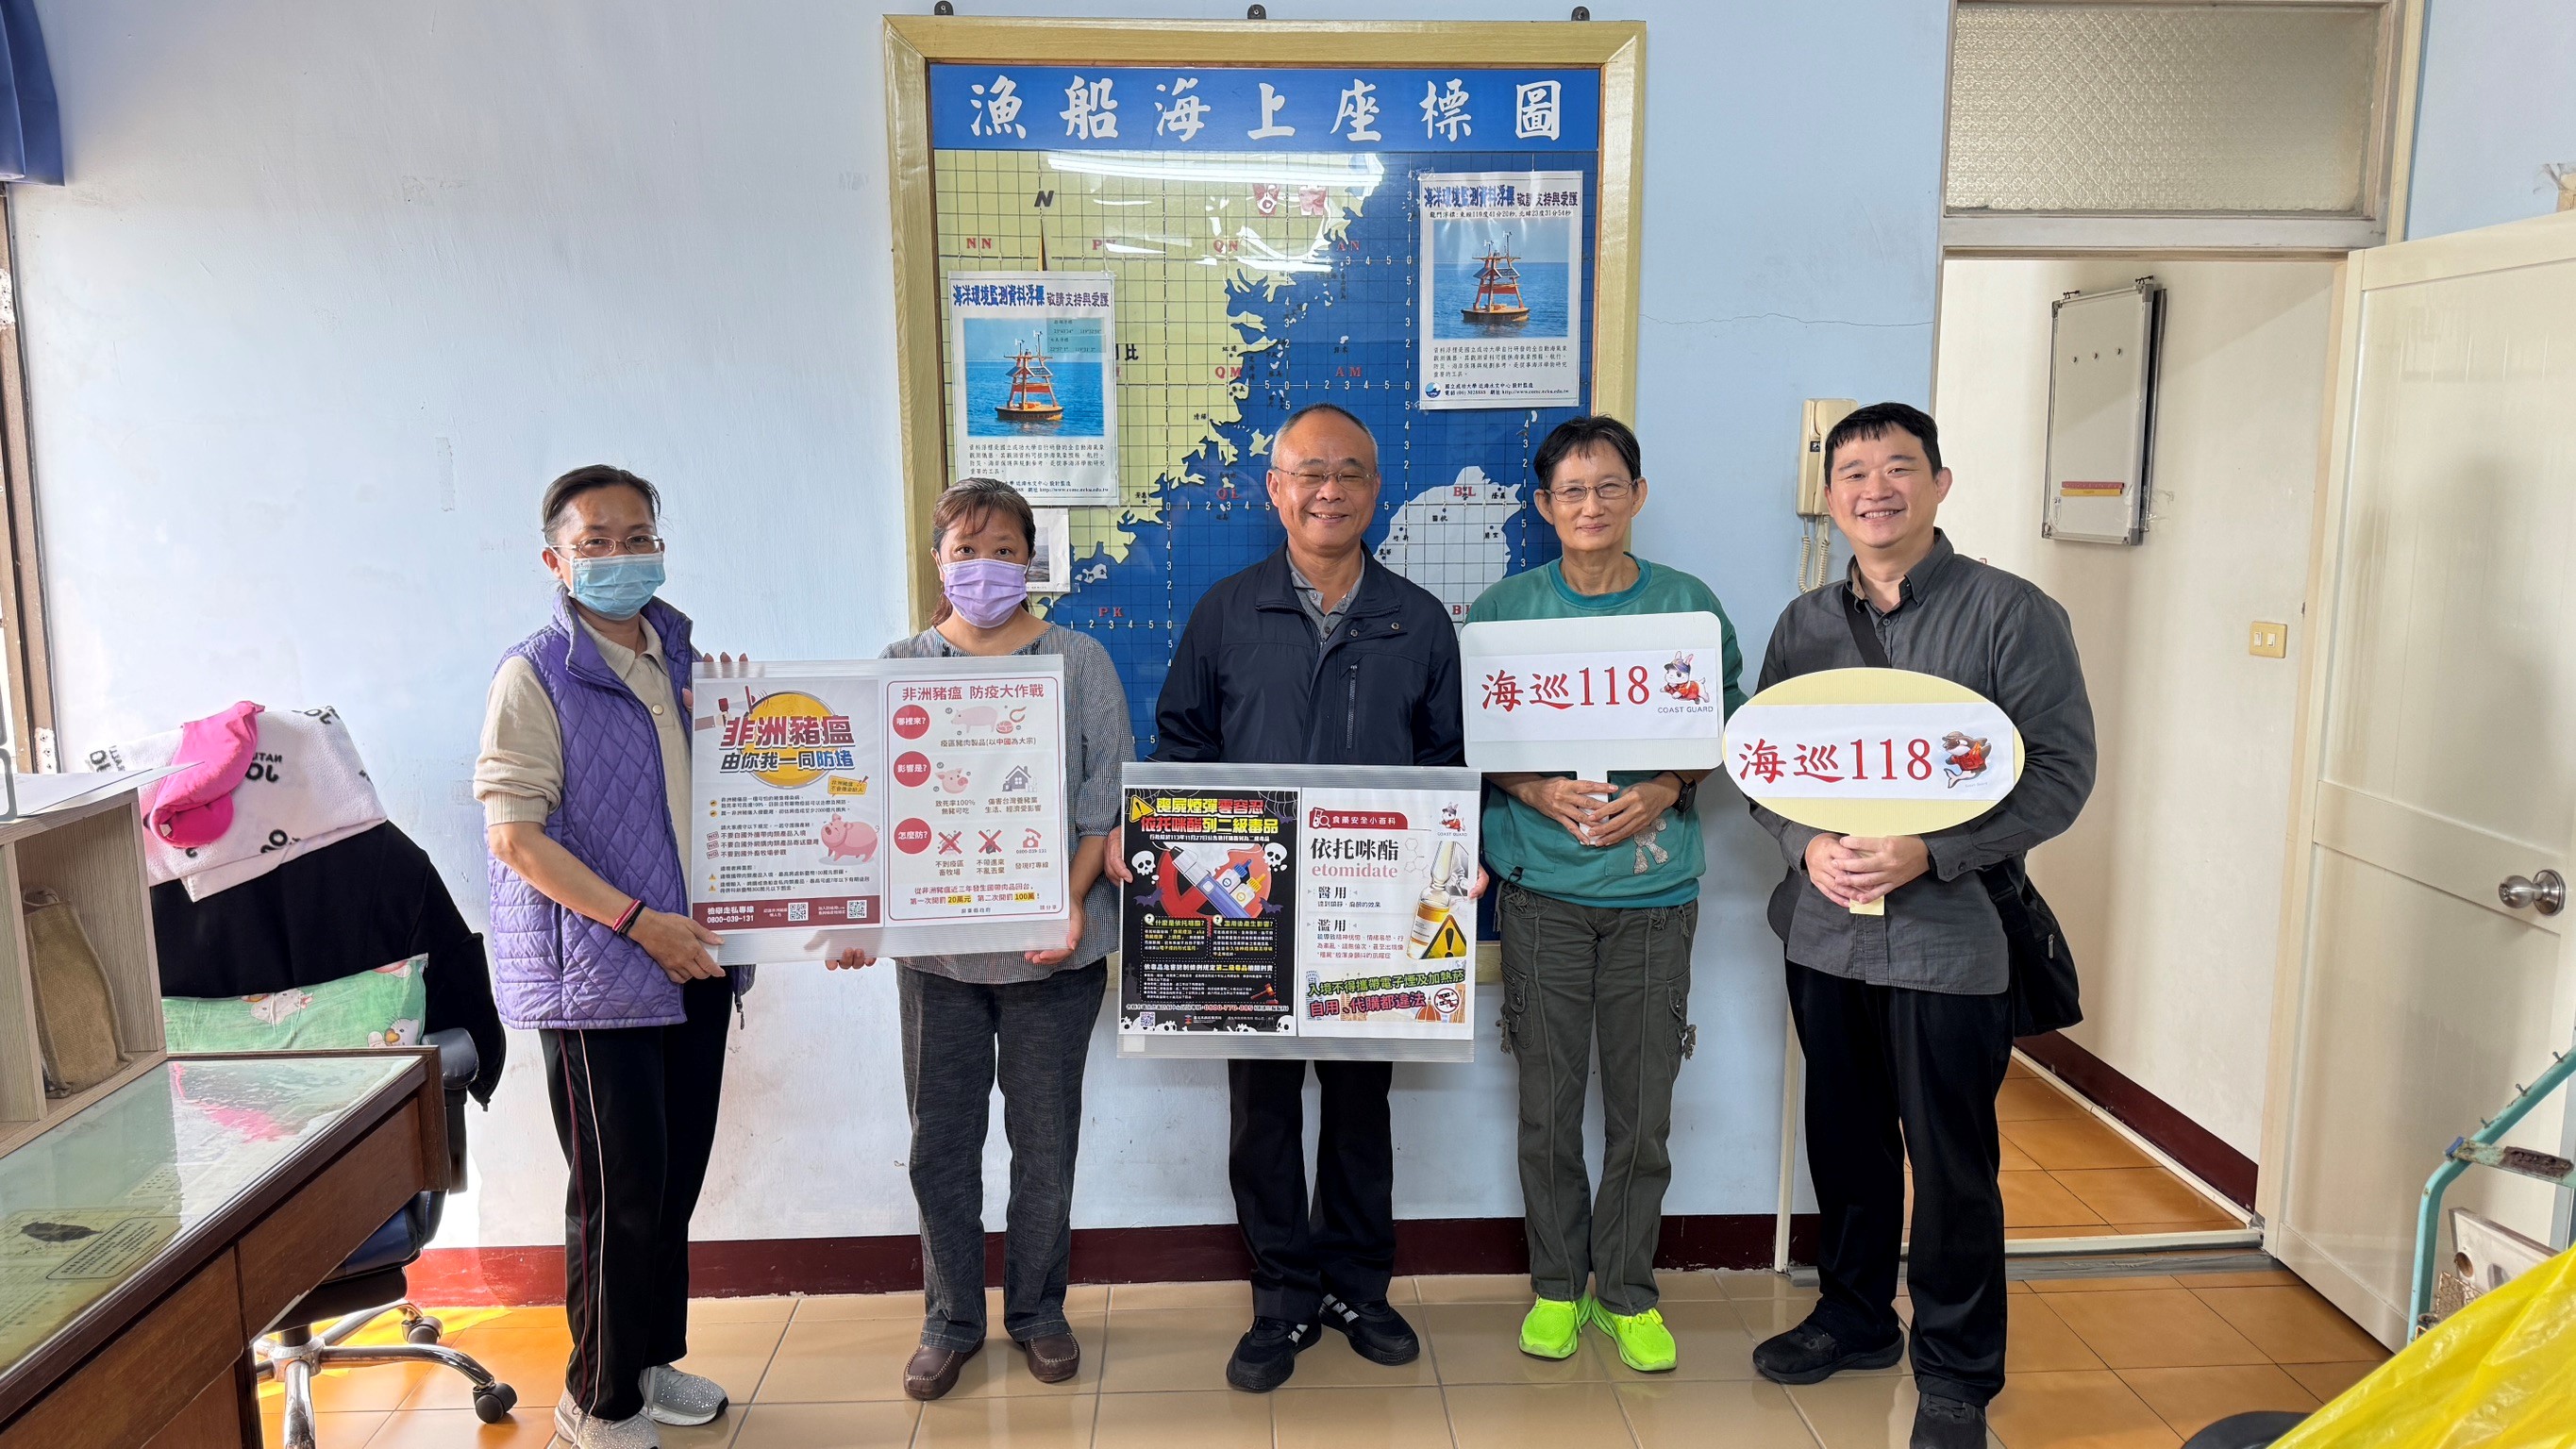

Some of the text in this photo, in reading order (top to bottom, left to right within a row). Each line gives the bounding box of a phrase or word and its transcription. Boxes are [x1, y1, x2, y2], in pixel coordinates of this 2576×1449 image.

[970, 75, 1562, 142] 漁船海上座標圖
[1034, 191, 1054, 207] N
[1047, 292, 1109, 307] 敬請支持與愛護
[902, 684, 1044, 701] 非洲豬瘟 防疫大作戰
[720, 716, 854, 749] 非洲豬瘟
[721, 751, 854, 771] 由你我一同防堵
[1156, 798, 1264, 814] 喪屍煙彈零容忍
[1141, 817, 1278, 834] 依托咪酯列二級毒品
[1333, 816, 1396, 825] 食藥安全小百科
[1311, 838, 1398, 861] 依托咪酯
[1312, 863, 1398, 878] etomidate
[1318, 887, 1346, 899] 醫用
[707, 915, 753, 923] 0800-039-131
[1318, 919, 1346, 931] 濫用
[1308, 970, 1465, 996] 入境不得攜帶電子煙及加熱菸
[1310, 994, 1426, 1017] 自用、代購都違法
